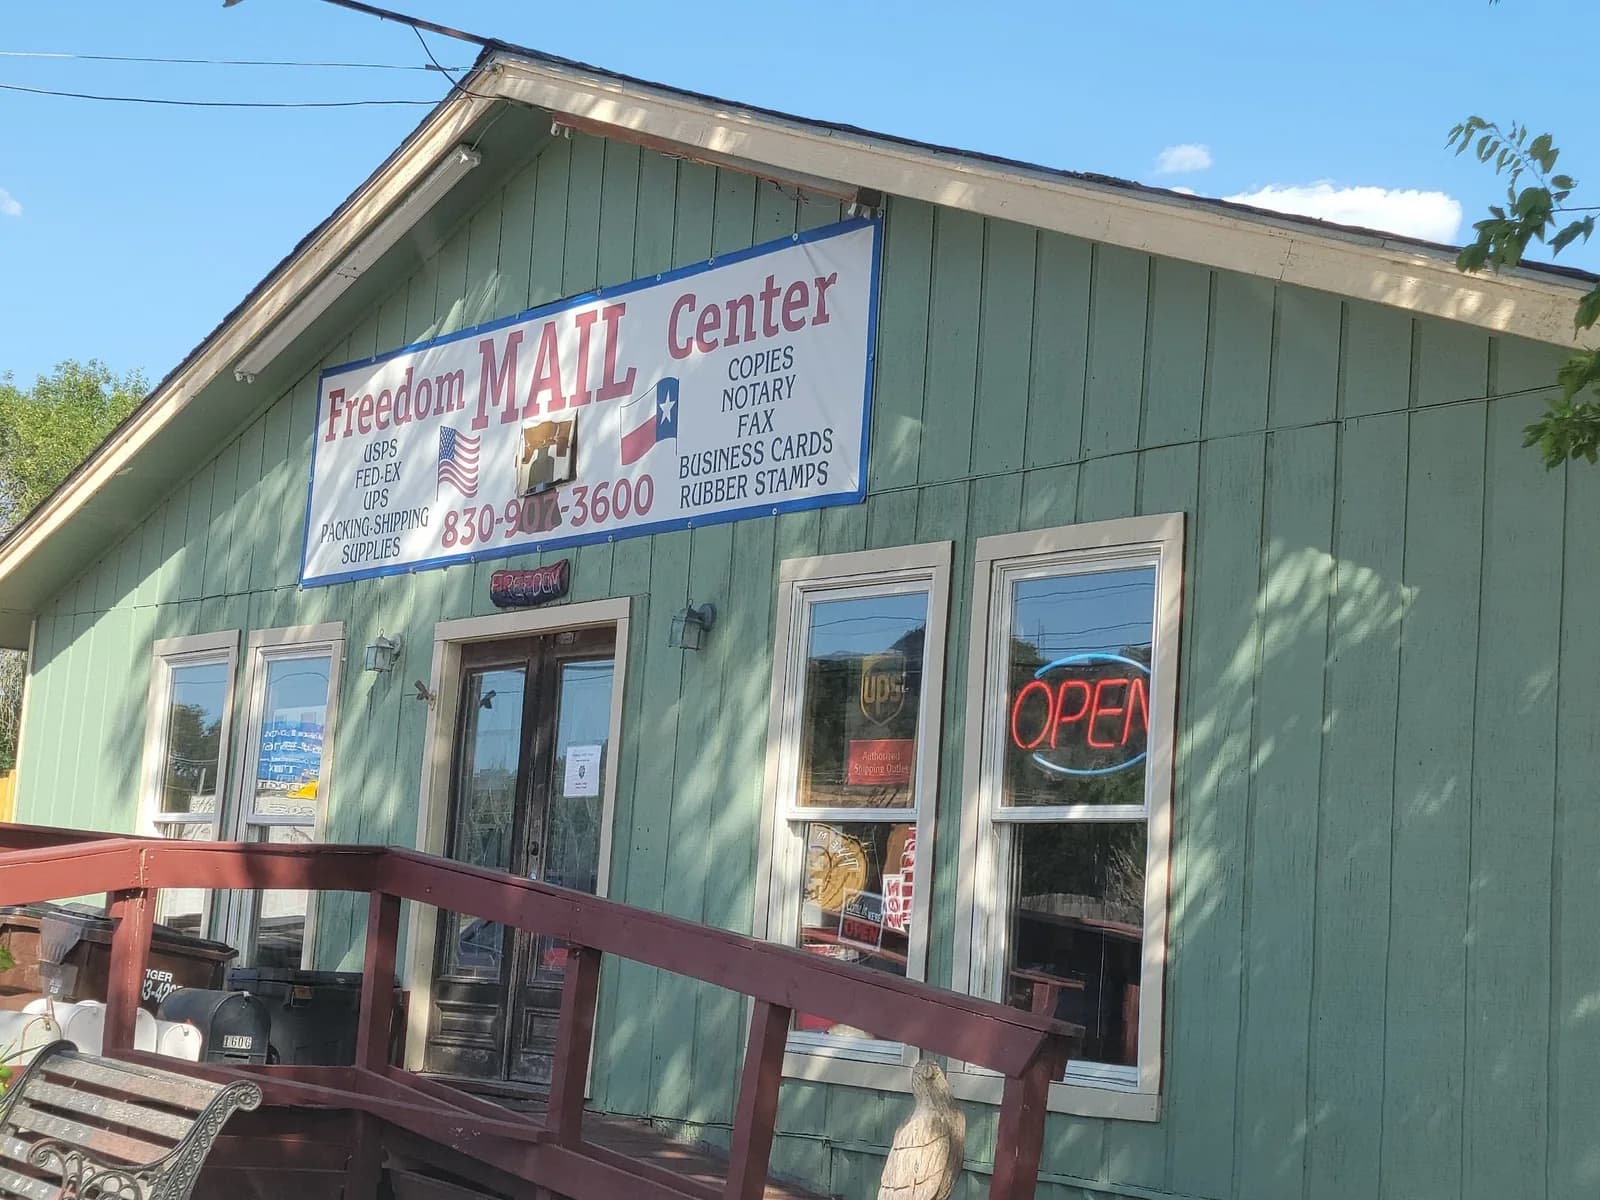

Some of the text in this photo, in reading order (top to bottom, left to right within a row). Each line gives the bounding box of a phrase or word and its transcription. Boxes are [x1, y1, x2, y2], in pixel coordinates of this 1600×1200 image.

[325, 272, 838, 442] Freedom MAIL Center
[728, 345, 794, 381] COPIES
[721, 374, 796, 412] NOTARY
[737, 408, 775, 438] FAX
[363, 438, 398, 464] USPS
[679, 428, 833, 479] BUSINESS CARDS
[363, 488, 388, 511] UPS
[680, 460, 829, 509] RUBBER STAMPS
[441, 474, 654, 549] 830-907-3600
[341, 537, 401, 565] SUPPLIES
[491, 567, 562, 600] FREEDOM
[1012, 677, 1150, 750] OPEN
[145, 968, 173, 982] IGER
[224, 1036, 251, 1049] 1606
